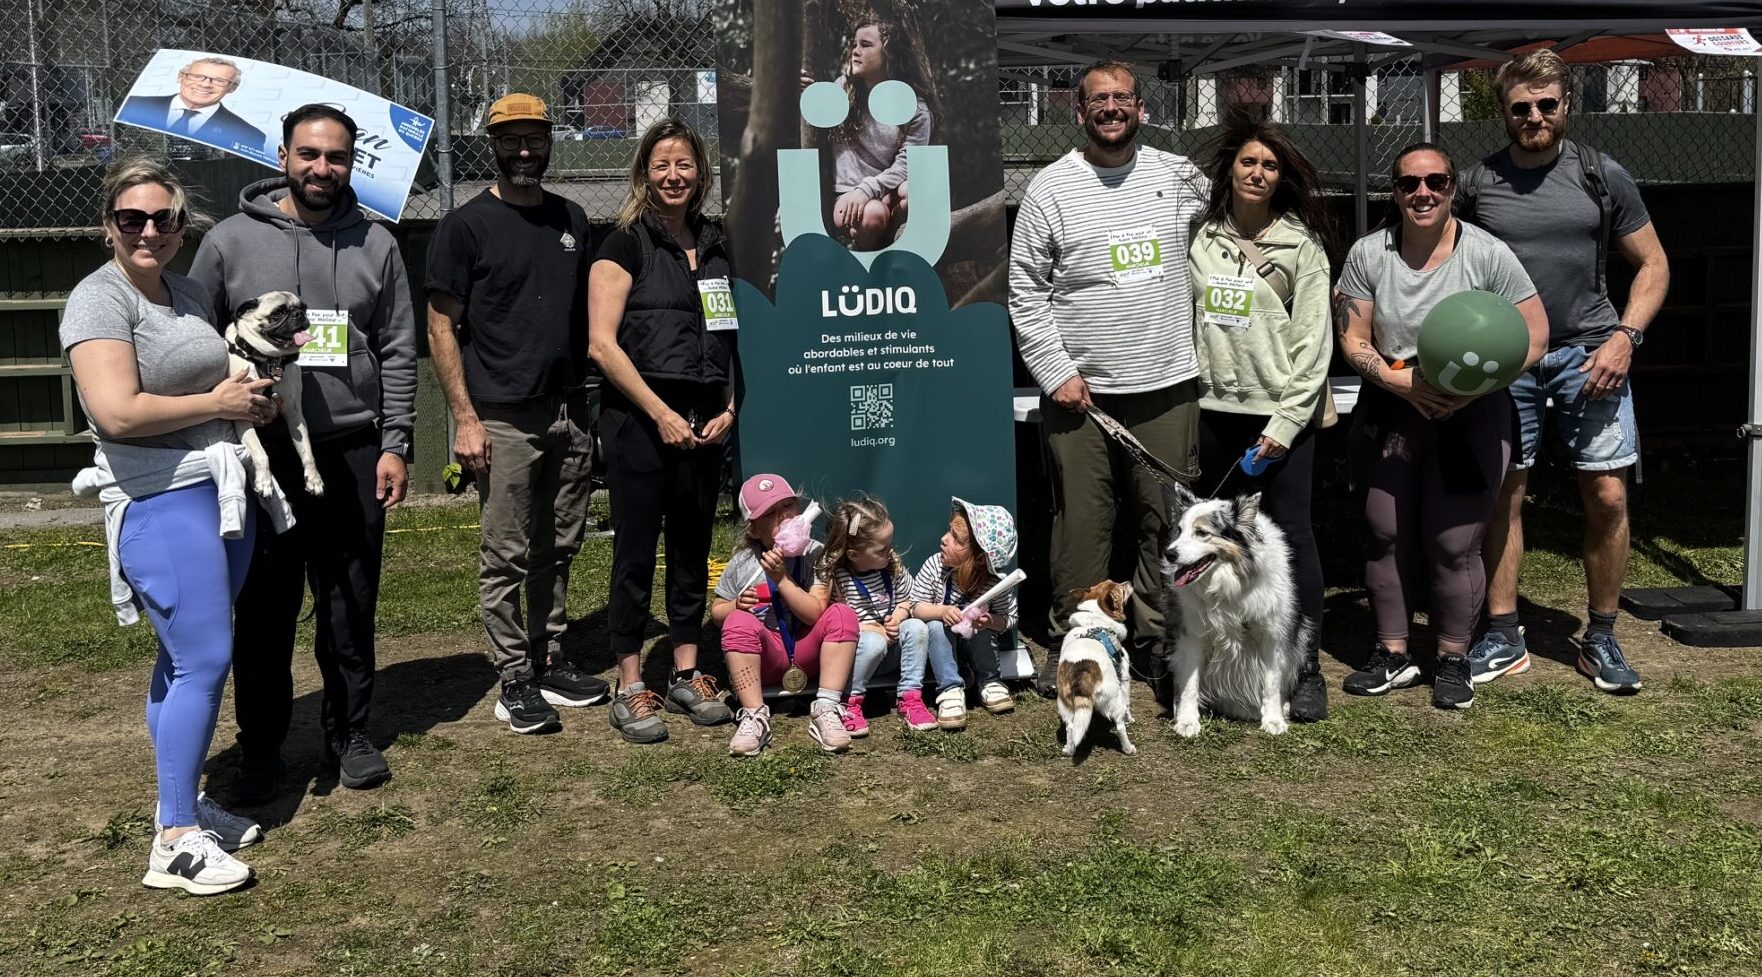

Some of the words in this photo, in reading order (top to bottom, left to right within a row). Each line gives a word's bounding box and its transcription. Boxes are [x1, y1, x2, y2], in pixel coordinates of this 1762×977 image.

[353, 147, 382, 170] ET
[1116, 241, 1155, 265] 039
[707, 292, 734, 313] 031
[821, 284, 917, 318] LÜDIQ
[1210, 287, 1247, 310] 032
[307, 325, 342, 348] 41
[821, 334, 842, 344] Des
[844, 332, 882, 343] milieux
[884, 330, 898, 340] de
[900, 329, 917, 339] vie
[803, 347, 865, 359] abordables
[867, 346, 878, 356] et
[880, 344, 935, 355] stimulants
[788, 364, 802, 375] où
[804, 363, 846, 374] l'enfant
[848, 362, 865, 371] est
[867, 362, 881, 370] au
[883, 360, 913, 370] coeur
[915, 358, 930, 368] de
[931, 358, 955, 368] tout
[851, 436, 896, 447] ludiq.org
